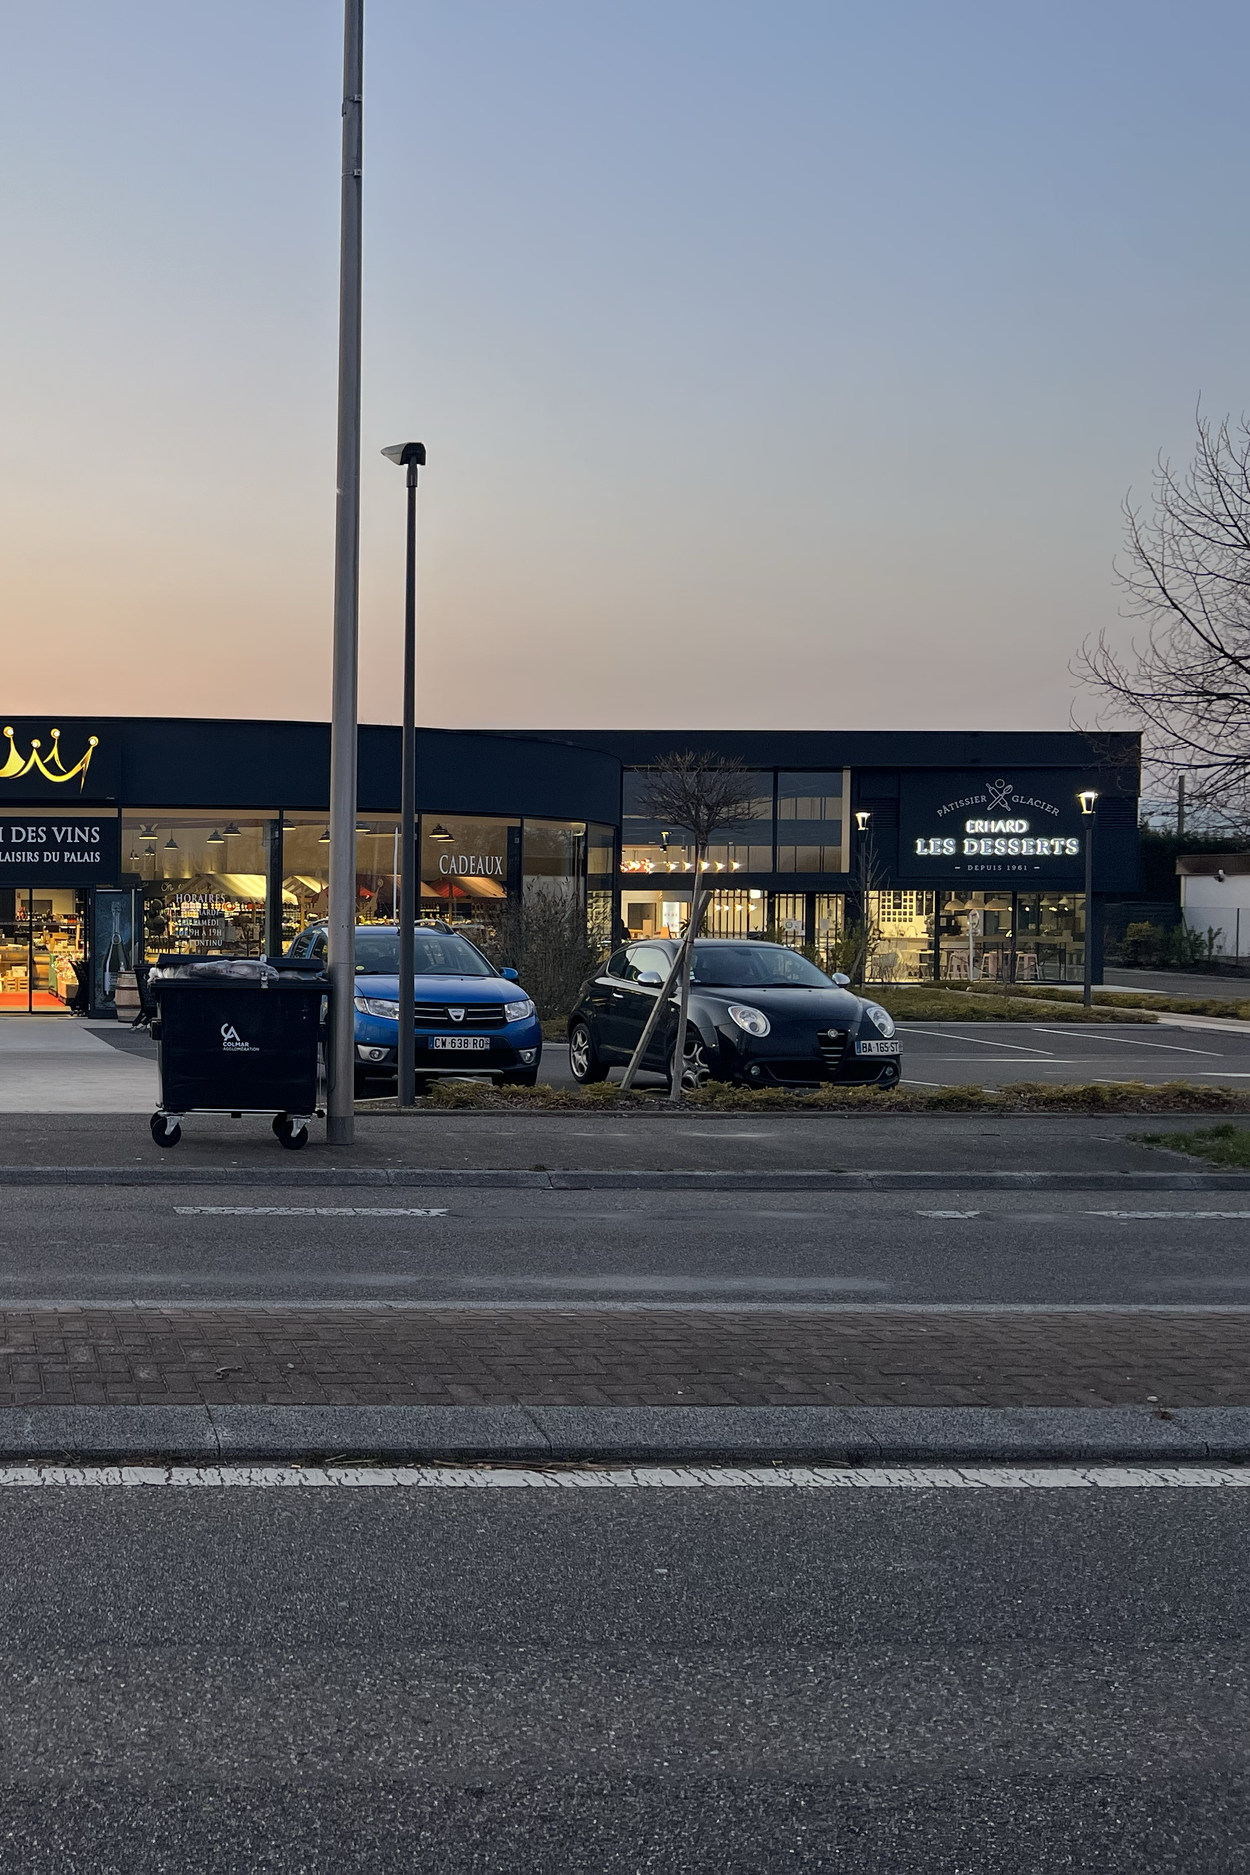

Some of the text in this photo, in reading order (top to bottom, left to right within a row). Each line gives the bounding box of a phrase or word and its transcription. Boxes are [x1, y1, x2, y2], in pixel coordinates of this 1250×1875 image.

[936, 795, 1060, 818] PÂTISSIER GLACIER
[10, 826, 47, 843] DES
[51, 826, 100, 843] VINS
[965, 819, 1030, 834] ERHARD
[916, 837, 1079, 855] LES DESSERTS
[64, 852, 101, 862] PALAIS
[439, 854, 503, 875] CADEAUX
[176, 893, 226, 903] HORAIRES
